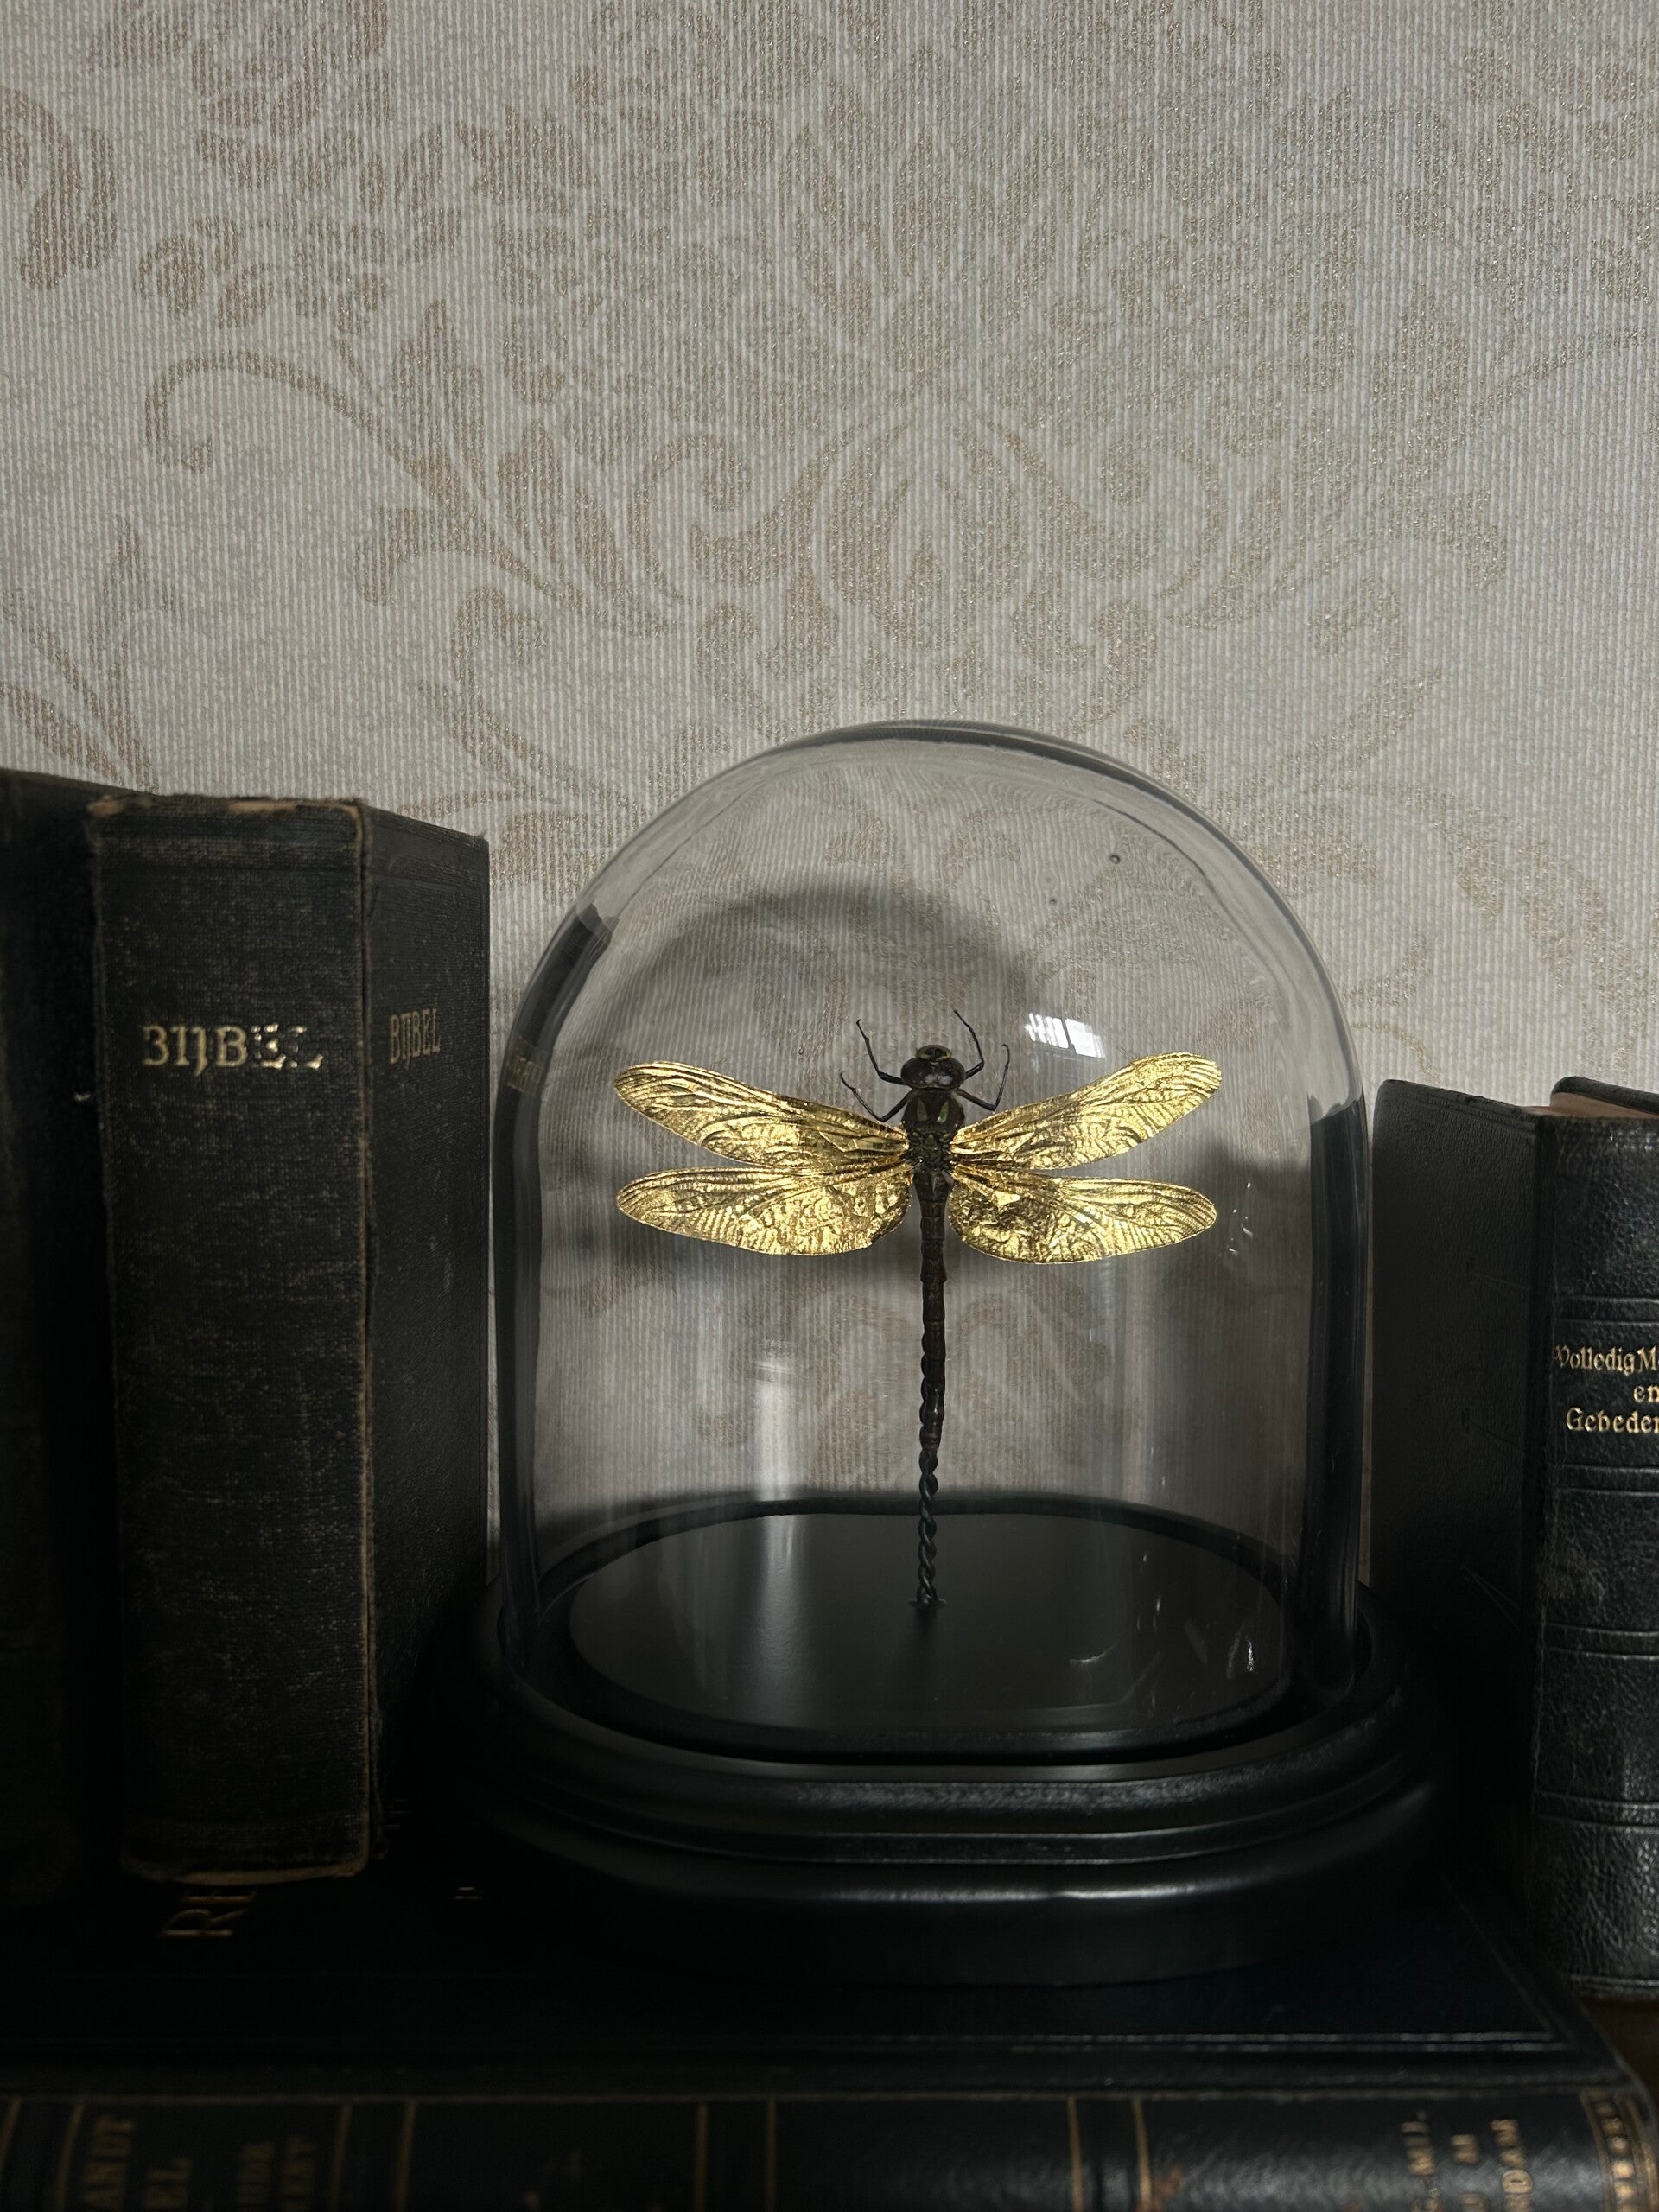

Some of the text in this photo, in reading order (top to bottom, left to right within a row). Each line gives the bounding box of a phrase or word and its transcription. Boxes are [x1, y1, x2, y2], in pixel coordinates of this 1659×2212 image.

[386, 1008, 441, 1071] BIJBEL
[1554, 1344, 1659, 1377] Volledig M
